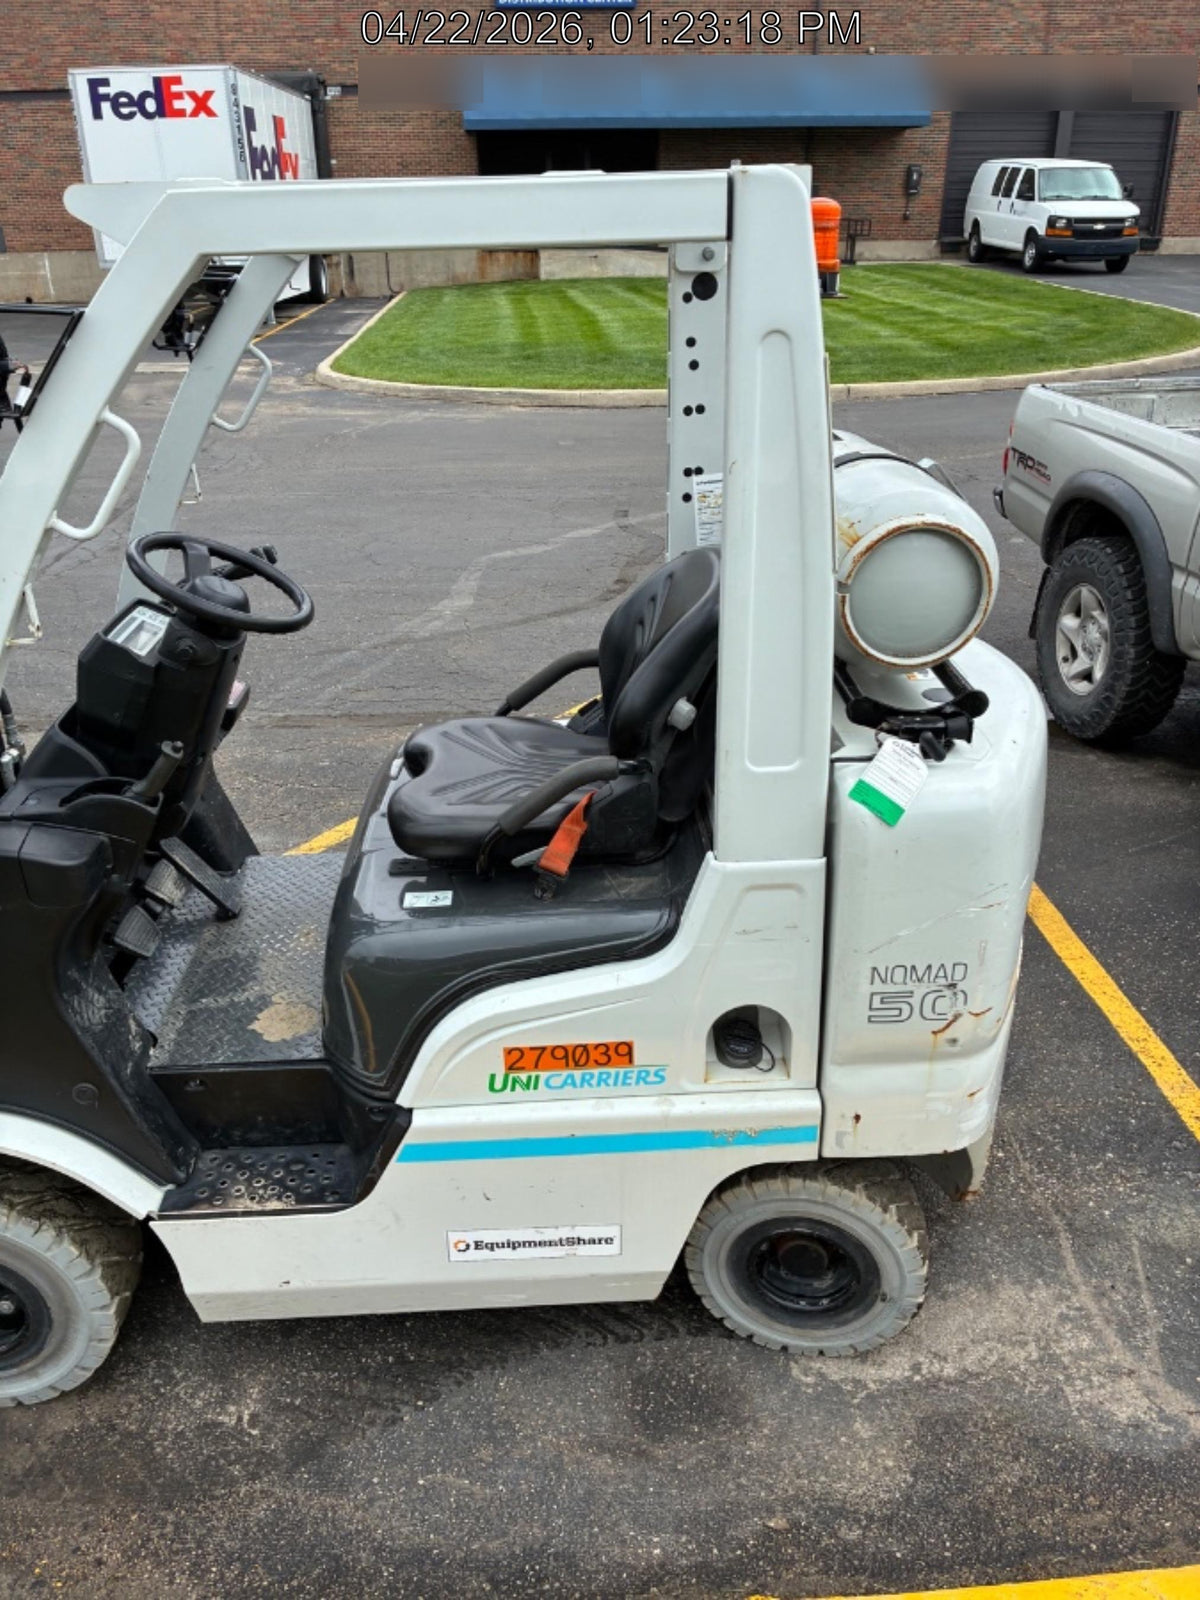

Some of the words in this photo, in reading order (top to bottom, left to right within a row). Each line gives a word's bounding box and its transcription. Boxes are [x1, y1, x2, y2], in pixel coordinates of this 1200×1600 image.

[87, 76, 218, 121] FedEx
[1011, 446, 1036, 471] TRD
[869, 962, 968, 986] NOMAD
[867, 989, 968, 1024] 50
[507, 1041, 634, 1071] 279039
[473, 1236, 614, 1252] EquipmentShare
